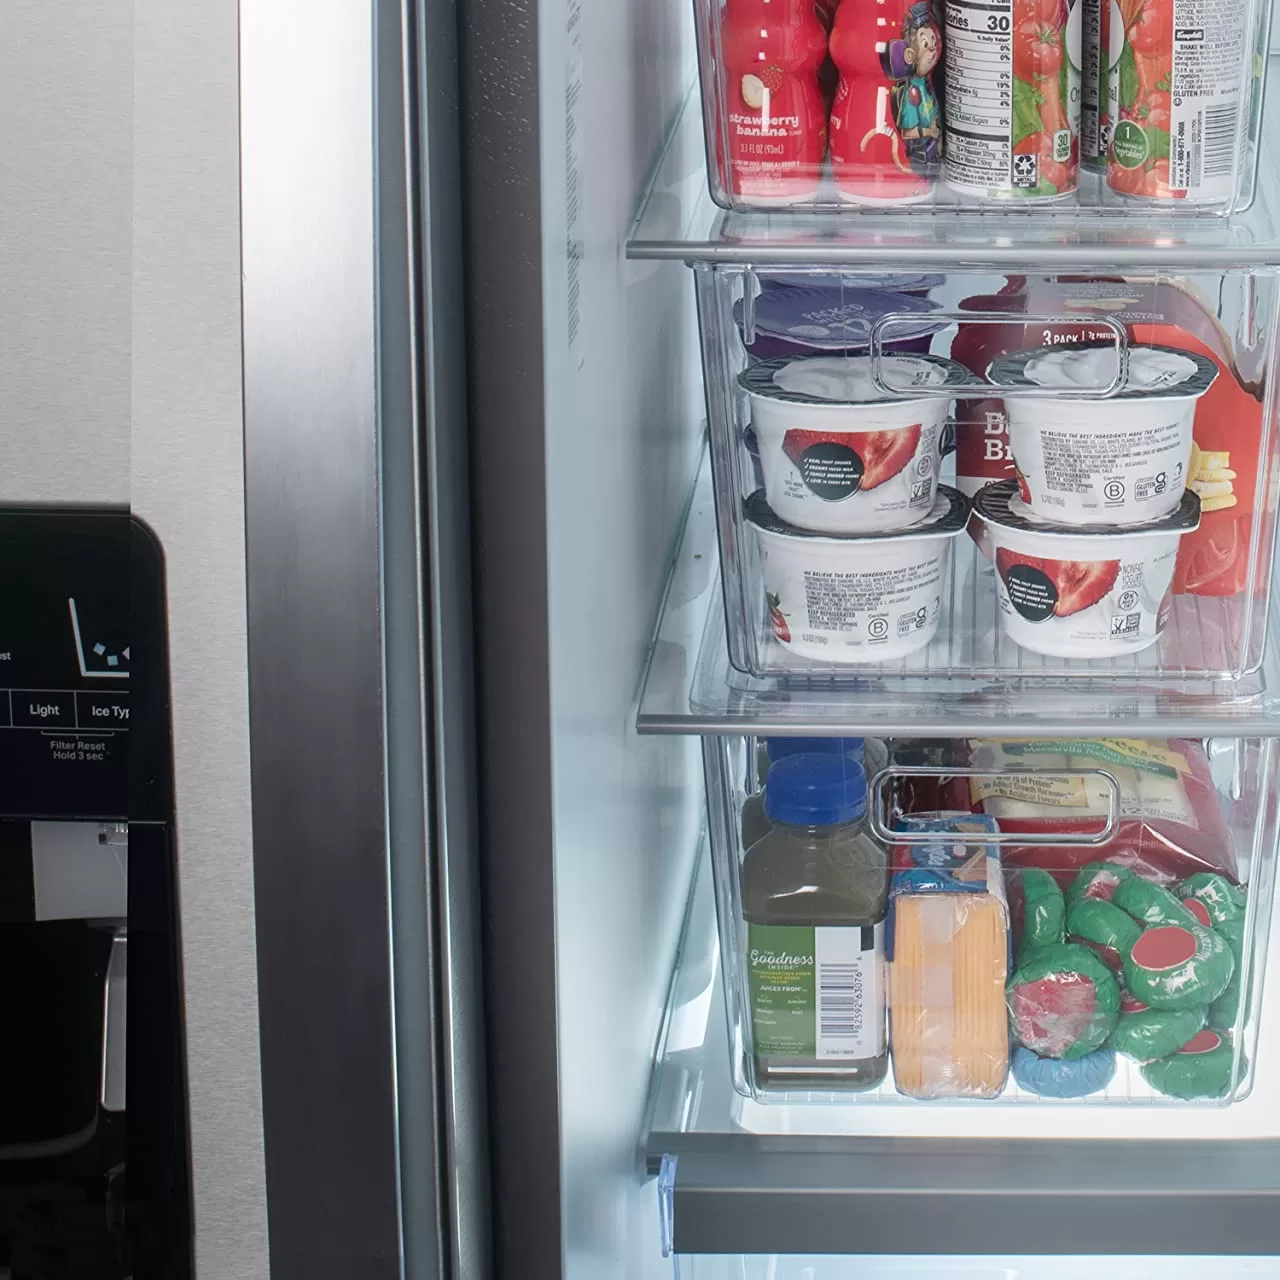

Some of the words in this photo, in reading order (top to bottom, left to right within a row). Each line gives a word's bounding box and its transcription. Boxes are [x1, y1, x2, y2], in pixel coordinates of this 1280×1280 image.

[987, 15, 1010, 31] 30
[1173, 89, 1198, 97] GLUTEN
[736, 124, 788, 136] banana
[1125, 126, 1130, 139] 1
[1057, 133, 1068, 147] 30
[1042, 330, 1050, 345] 3
[1109, 484, 1120, 497] B
[1136, 482, 1156, 490] GLUTEN
[1123, 562, 1144, 574] NONFAT
[1122, 573, 1143, 585] YOGURT
[873, 621, 884, 634] B
[29, 703, 60, 717] Light
[92, 705, 110, 717] Ice
[50, 740, 76, 750] Filter
[77, 741, 106, 751] Reset
[53, 751, 76, 760] Hold
[78, 751, 85, 760] 3
[86, 752, 104, 760] sec
[750, 949, 814, 966] Goodness
[854, 971, 863, 1000] 63076
[854, 1002, 863, 1030] 82592
